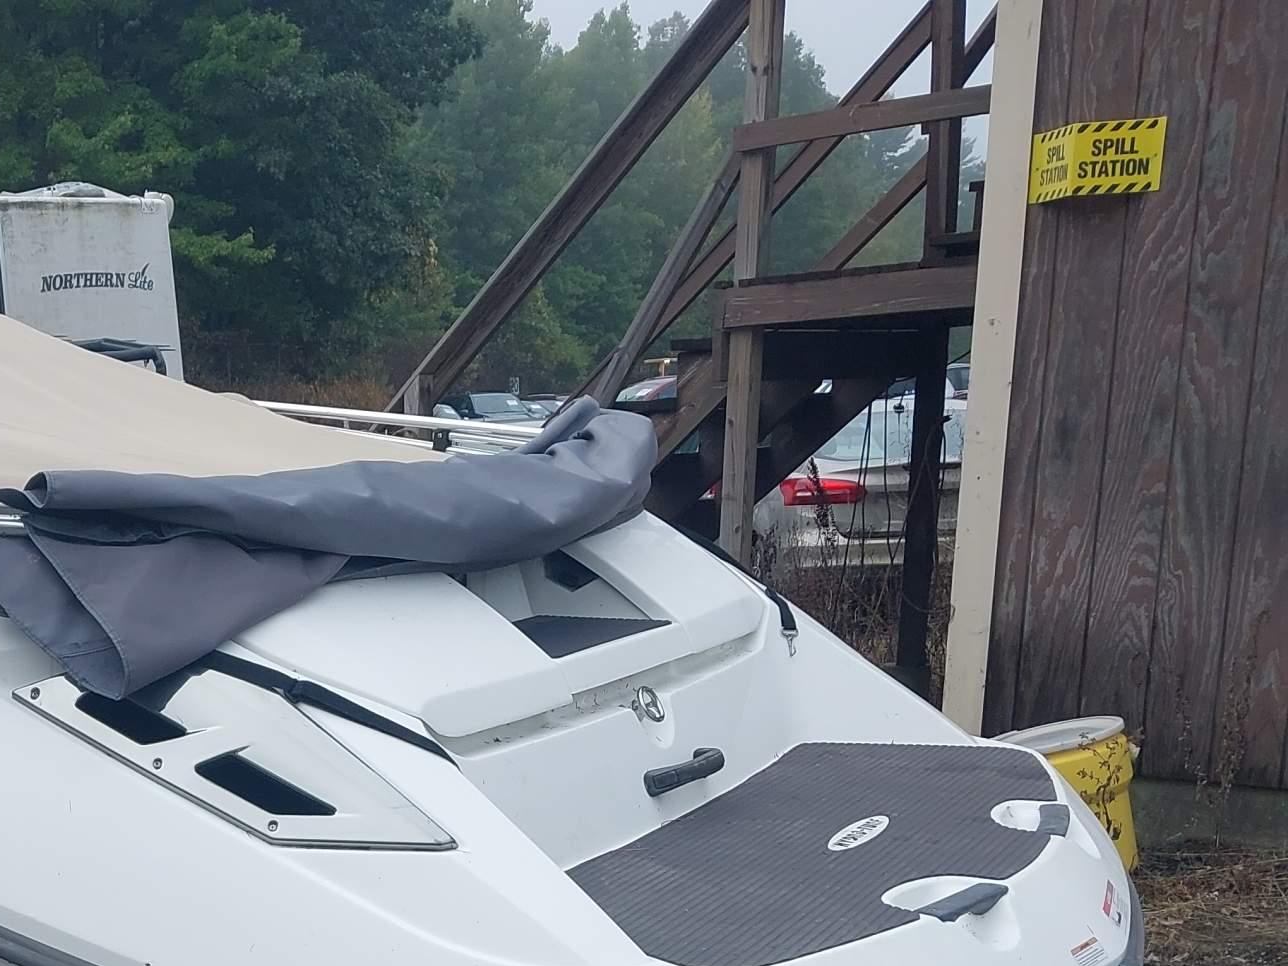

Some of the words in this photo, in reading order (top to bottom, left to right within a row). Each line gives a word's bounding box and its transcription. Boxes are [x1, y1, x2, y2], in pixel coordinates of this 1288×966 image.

[1046, 143, 1065, 165] SPILL
[1092, 136, 1139, 157] SPILL
[1039, 165, 1068, 186] STATION
[1077, 158, 1149, 179] STATION
[40, 272, 126, 293] NORTHERN
[127, 263, 154, 291] Lite
